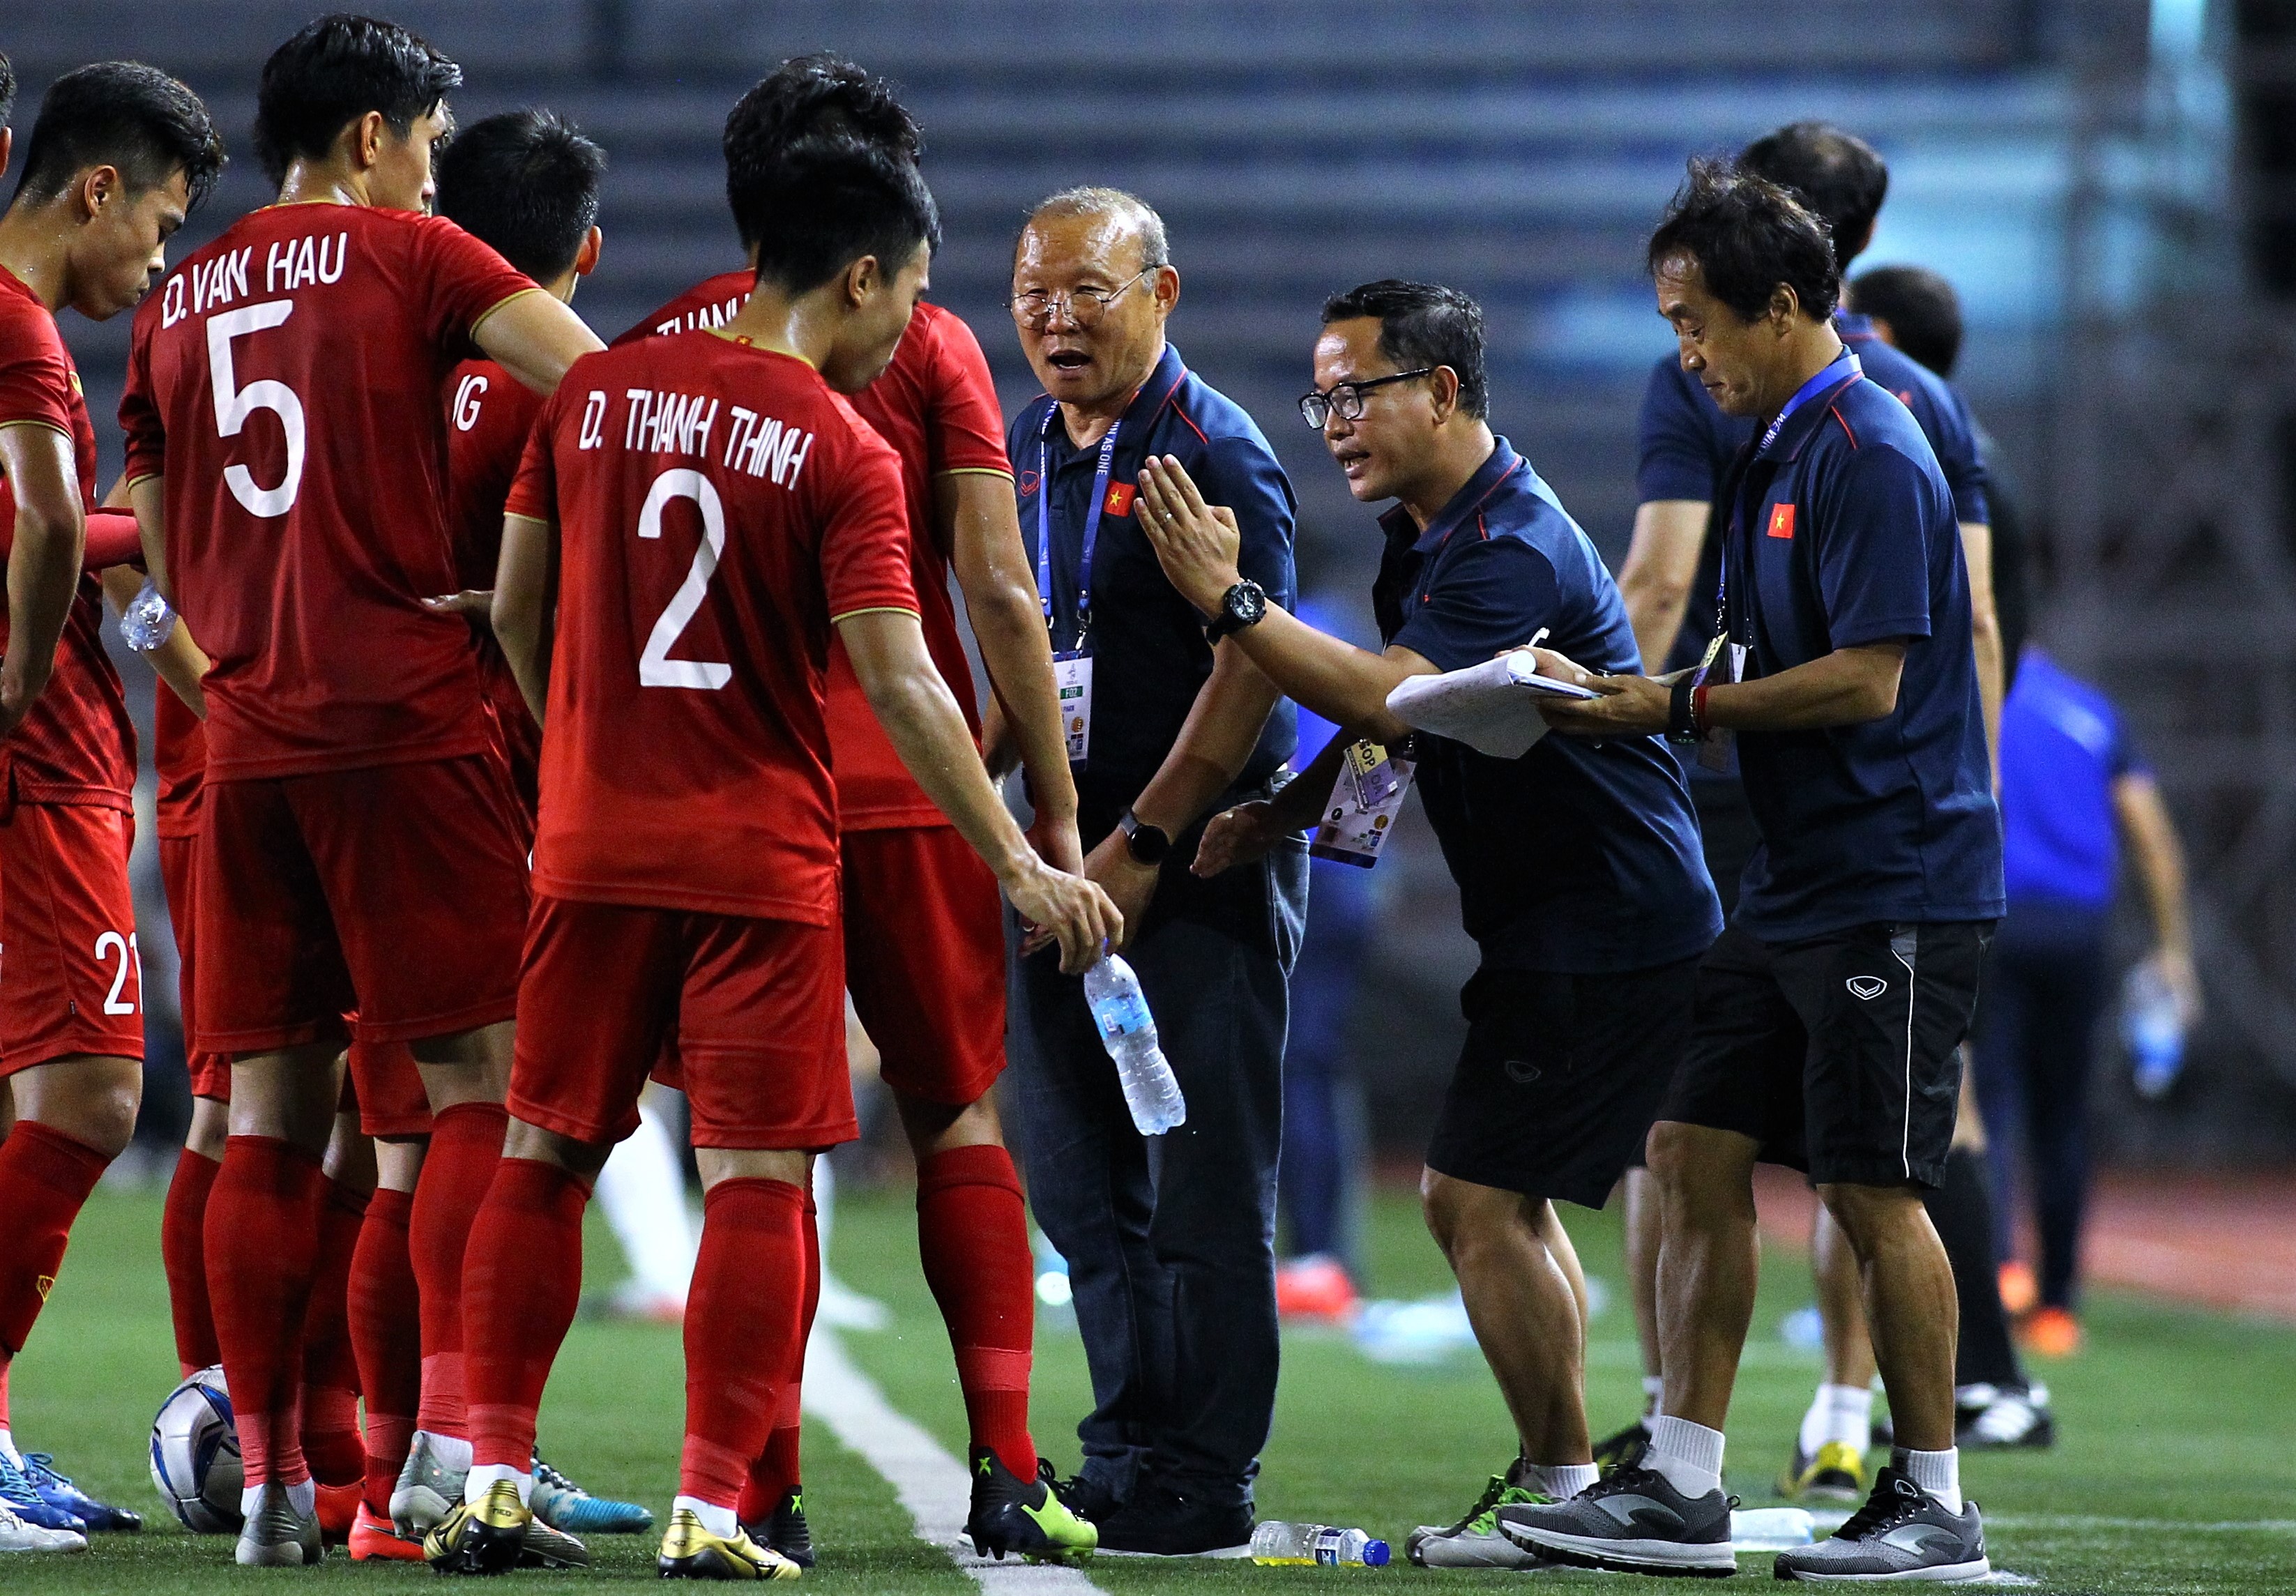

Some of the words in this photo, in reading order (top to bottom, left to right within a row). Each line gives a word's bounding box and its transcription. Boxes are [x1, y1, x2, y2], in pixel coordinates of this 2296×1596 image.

[266, 232, 347, 293] HAU
[206, 298, 306, 518] 5
[579, 390, 602, 450] D.
[626, 388, 719, 457] THANH
[724, 405, 814, 491] THINH
[1102, 436, 1114, 452] AS
[1096, 454, 1111, 476] ONE
[637, 467, 733, 690] 2
